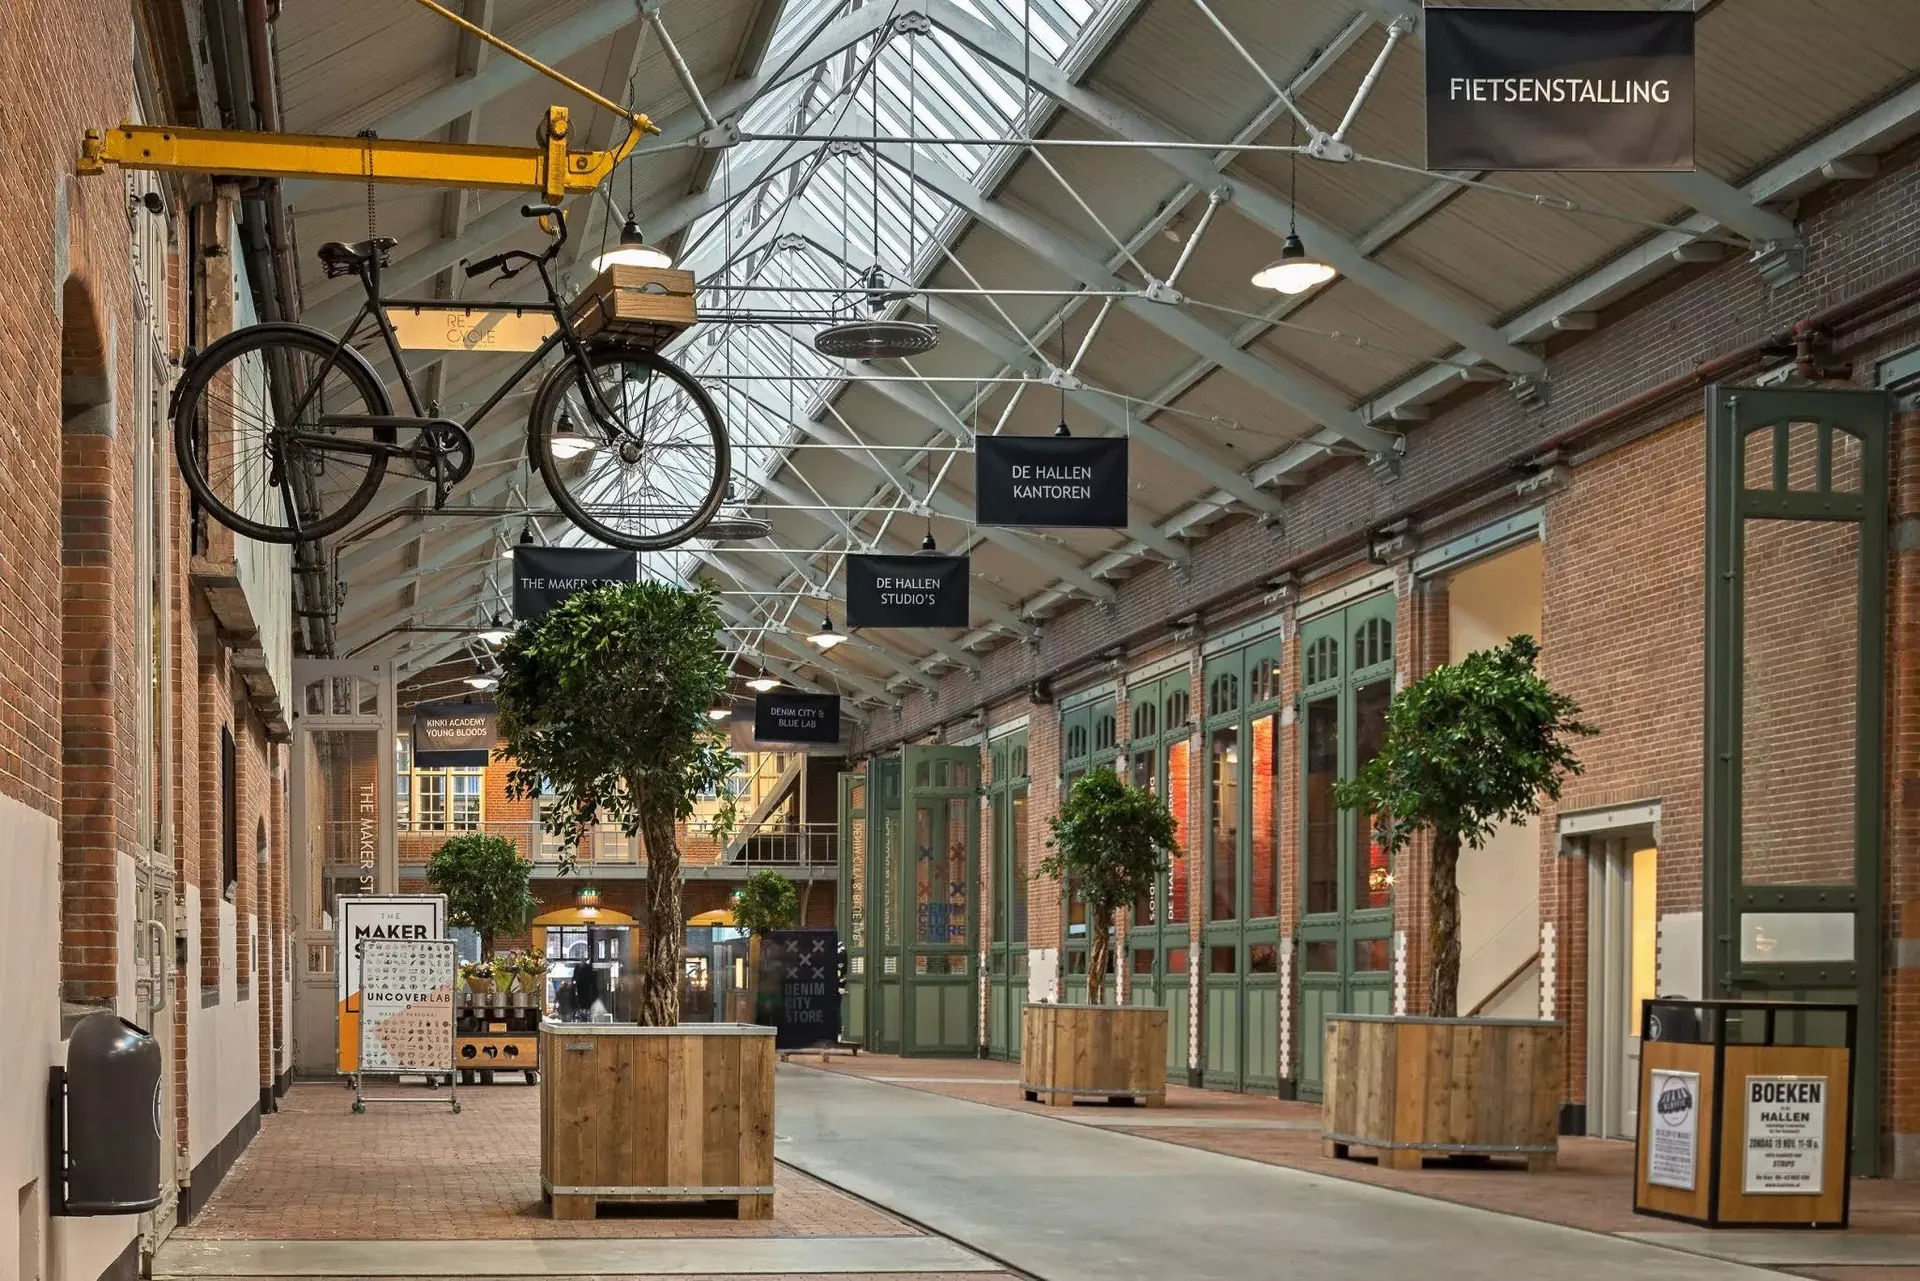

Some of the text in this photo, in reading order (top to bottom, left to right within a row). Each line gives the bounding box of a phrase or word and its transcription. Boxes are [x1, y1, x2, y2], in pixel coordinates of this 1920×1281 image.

[1450, 78, 1670, 103] FIETSENSTALLING
[446, 329, 496, 344] CYCLE
[1012, 465, 1092, 479] DE HALLEN
[1013, 485, 1091, 499] KANTOREN
[520, 578, 544, 589] THE
[876, 577, 941, 589] DE HALLEN
[881, 593, 936, 605] STUDIO'S
[770, 707, 824, 718] DENIM CITY &
[427, 718, 486, 727] KINKI ACADEMY
[778, 719, 817, 728] BLUE LAB
[426, 728, 487, 737] YOUNG BLOODS
[360, 782, 374, 813] THE
[360, 817, 374, 870] MAKER
[355, 924, 428, 940] MAKER
[784, 983, 825, 995] DENIM
[785, 1010, 824, 1024] STORE
[1751, 1083, 1821, 1103] BOEKEN
[1761, 1112, 1810, 1122] HALLEN
